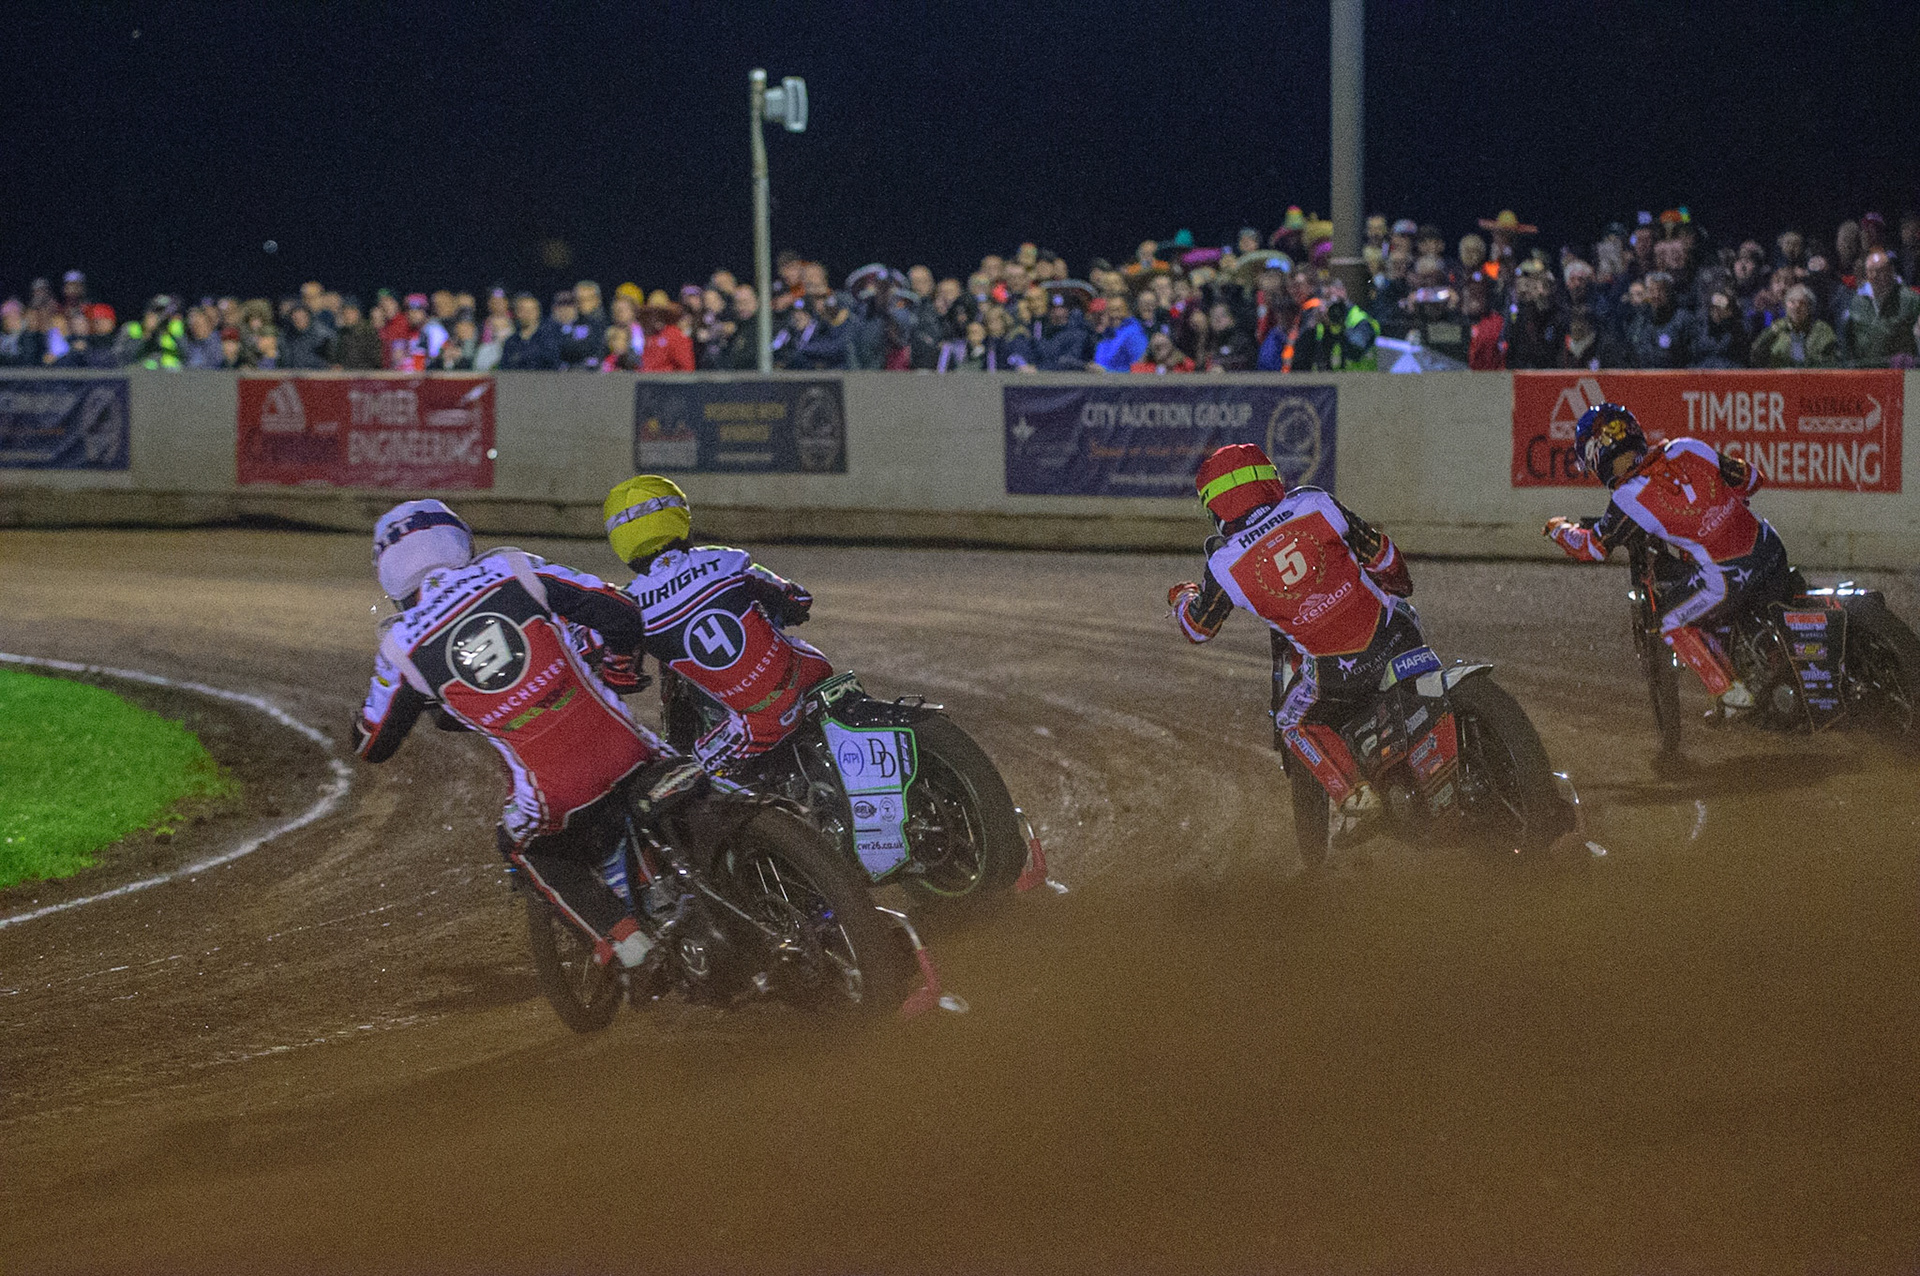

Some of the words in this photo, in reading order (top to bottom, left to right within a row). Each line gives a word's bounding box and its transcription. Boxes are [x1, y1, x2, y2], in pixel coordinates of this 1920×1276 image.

[1081, 403, 1118, 427] CITY
[1119, 402, 1192, 427] AUCTION
[1195, 402, 1253, 427] GROUP
[1682, 390, 1786, 432] TIMBER
[1237, 509, 1294, 549] HARRIS
[637, 557, 721, 609] WRIGHT
[1273, 541, 1308, 586] 5
[1292, 580, 1352, 627] Crendon
[692, 614, 737, 658] 4
[714, 636, 781, 699] MANCHESTER
[480, 658, 567, 726] MANCHESTER
[842, 752, 861, 765] ATPI
[857, 838, 904, 850] cwr26.co.uk
